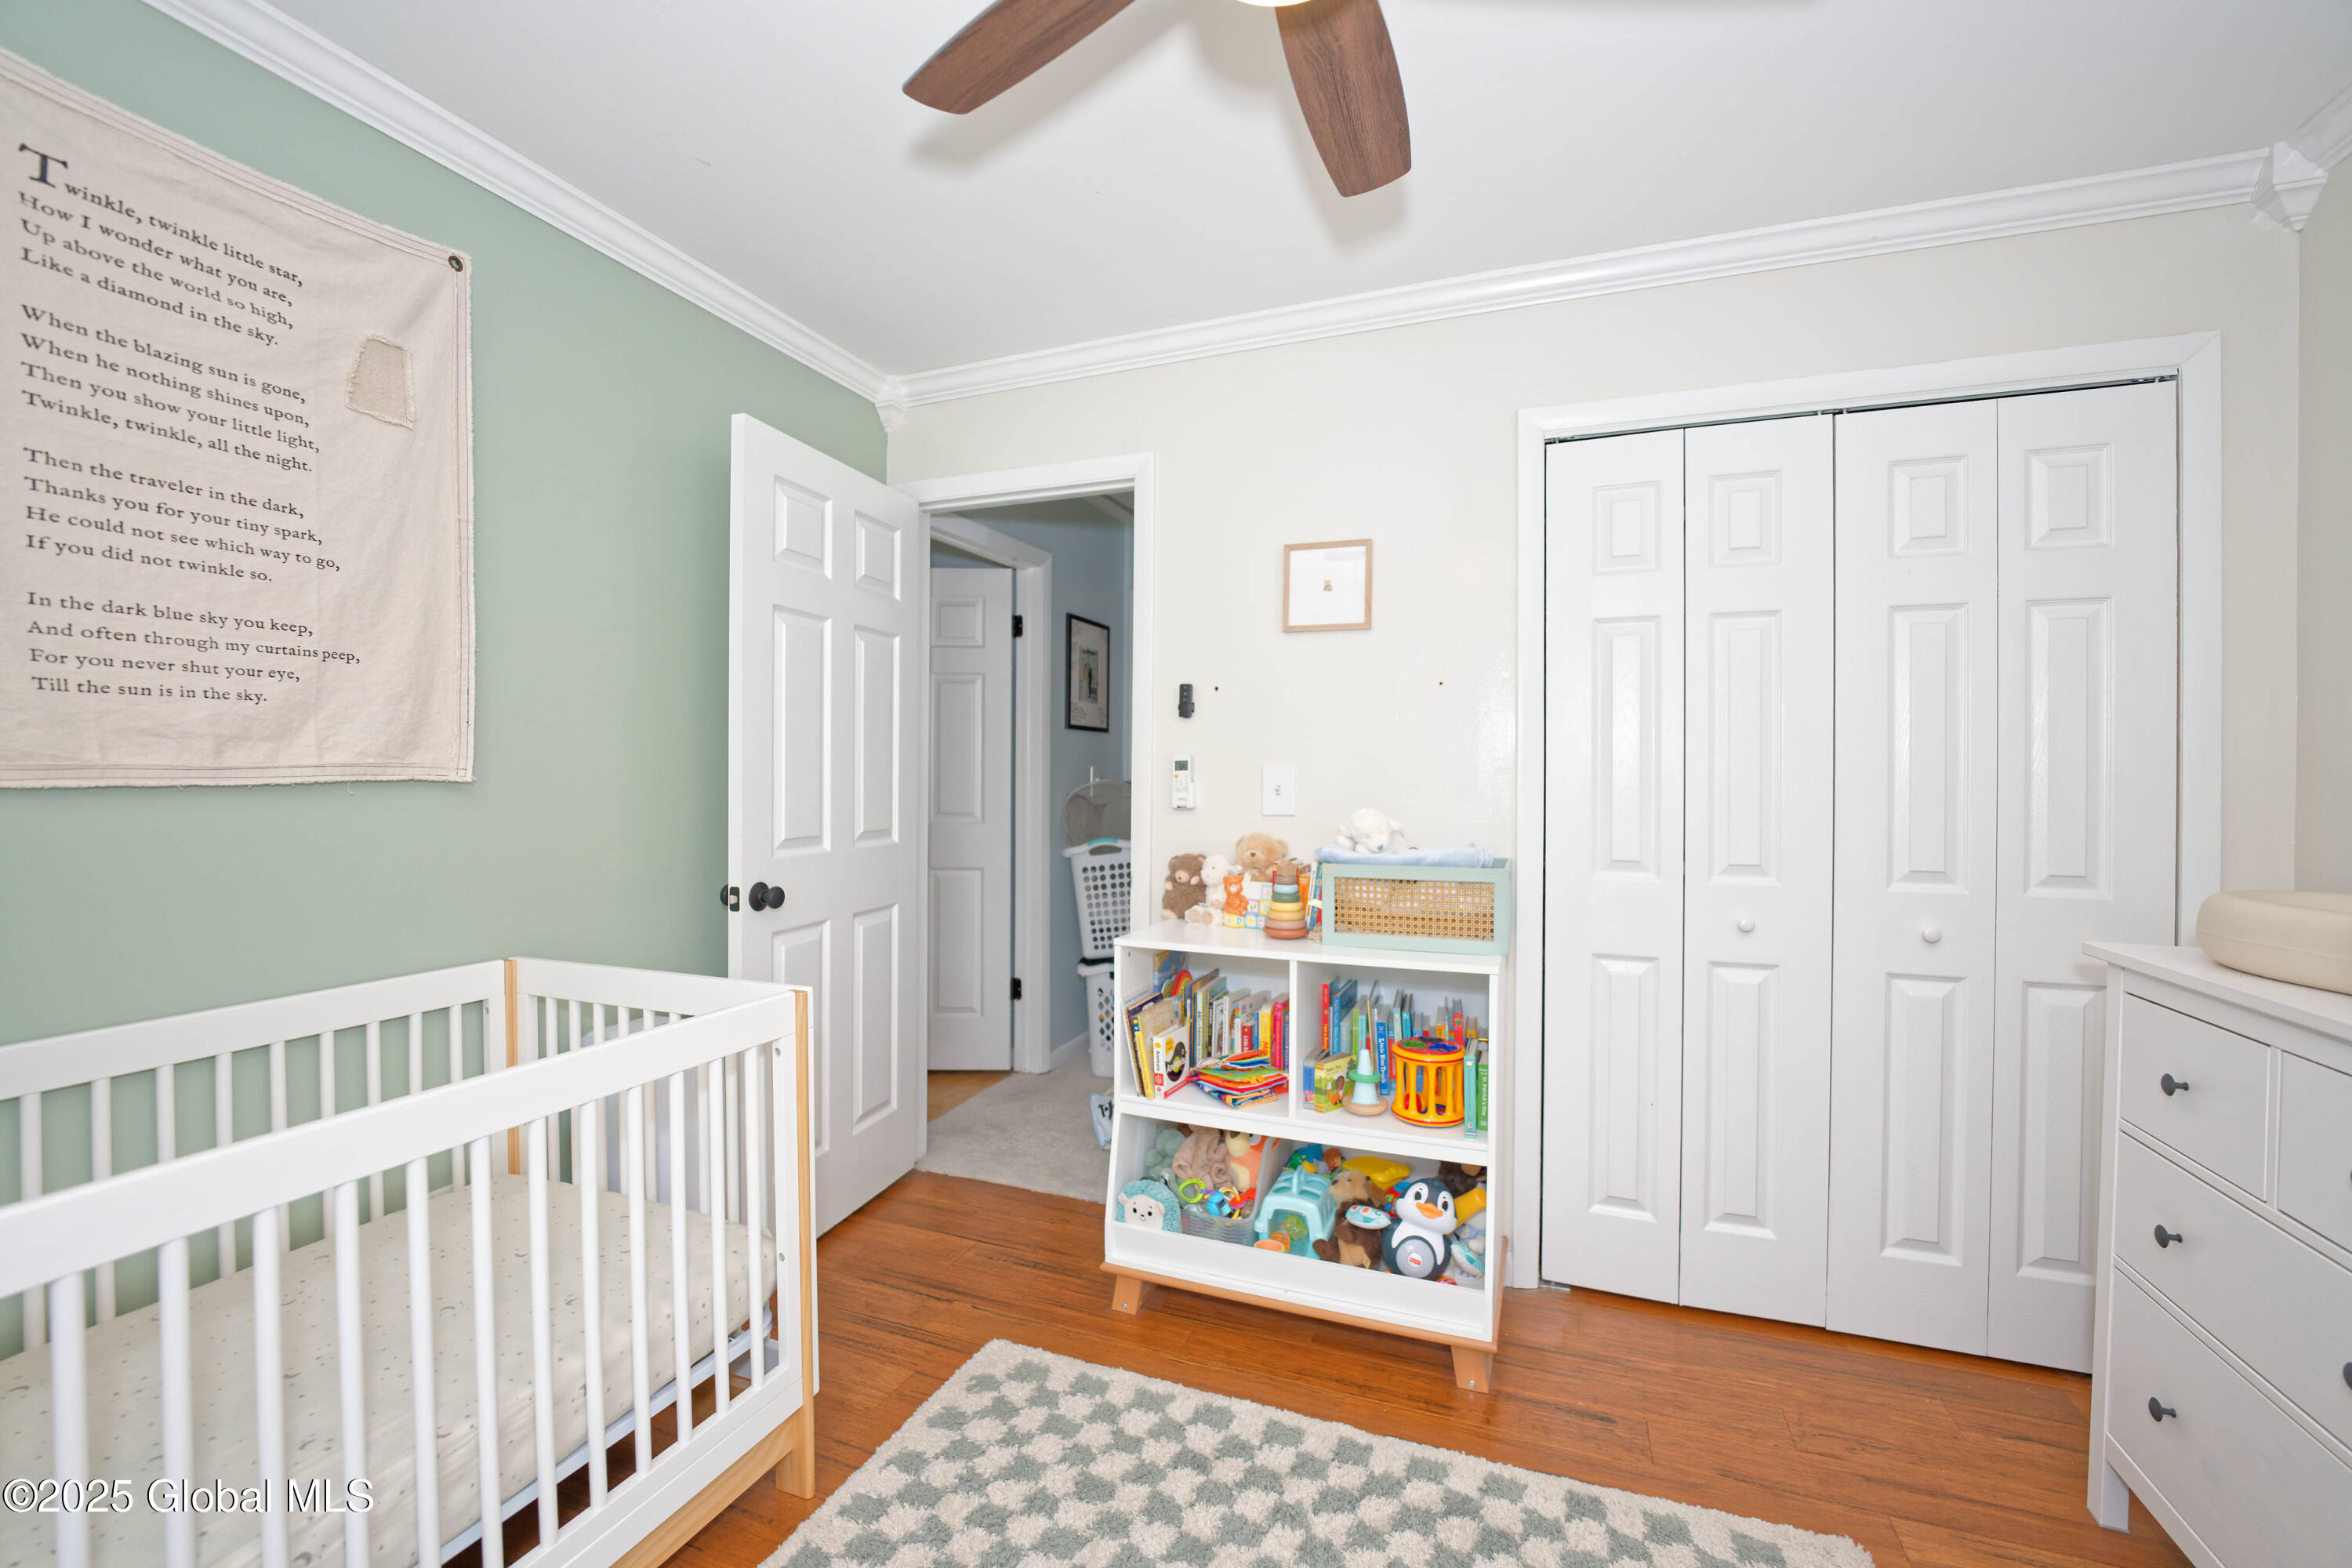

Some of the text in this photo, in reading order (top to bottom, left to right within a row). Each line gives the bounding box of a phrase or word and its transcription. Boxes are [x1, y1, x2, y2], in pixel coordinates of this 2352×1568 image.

[18, 191, 293, 307] How I wonder what you are,
[20, 217, 294, 330] Up above the world so high,
[148, 215, 219, 252] twinkle
[223, 242, 264, 270] little
[267, 264, 303, 288] star,
[20, 246, 278, 347] Like a diamond in the sky.
[20, 303, 306, 405] When the blazing sun is gone,
[20, 332, 310, 429] When he nothing shines upon,
[20, 361, 320, 454] Then you show your little light,
[20, 389, 313, 473] Twinkle, twinkle, all the night.
[22, 446, 304, 520] Then the traveler in the dark,
[23, 475, 323, 546] Thanks you for your tiny spark,
[24, 505, 340, 572] He could not see which way to go,
[25, 533, 273, 582] If you did not twinkle so.
[27, 591, 314, 637] In the dark blue sky you keep,
[27, 620, 361, 665] And often through my curtains peep,
[28, 648, 300, 684] For you never shut your eye,
[31, 675, 267, 706] Till the sun is in the sky.
